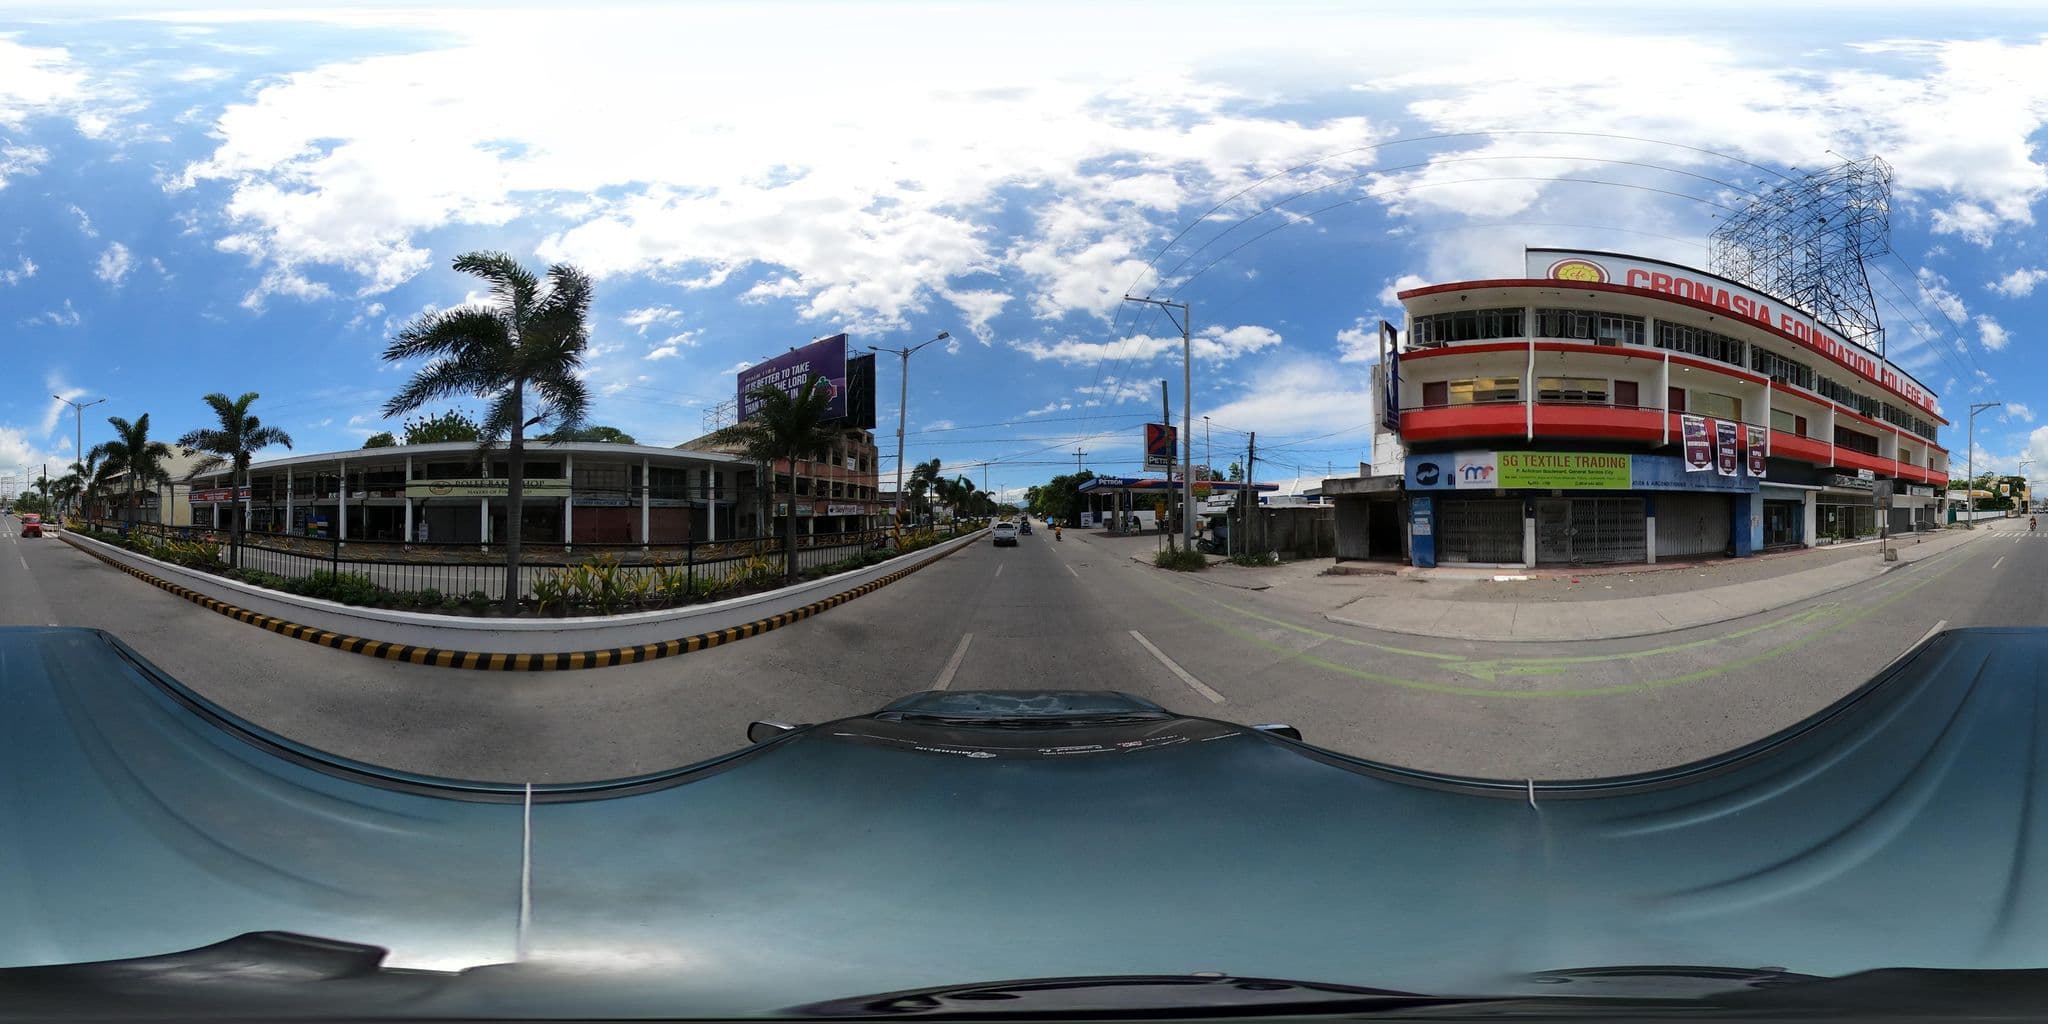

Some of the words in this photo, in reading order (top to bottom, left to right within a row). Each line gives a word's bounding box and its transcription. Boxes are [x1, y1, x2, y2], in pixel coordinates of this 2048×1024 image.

[1626, 268, 1771, 326] CRONASIA
[1780, 313, 1876, 380] FOUNDATION
[1881, 367, 1922, 405] COLLEGE
[757, 371, 780, 388] BETTER
[781, 368, 791, 379] TO
[792, 361, 810, 376] TAKE
[774, 379, 788, 391] THE
[788, 373, 808, 388] LORD
[790, 386, 799, 400] IN
[745, 399, 760, 415] THAN
[1502, 455, 1518, 467] 5G
[1523, 455, 1570, 468] TEXTILE
[1575, 456, 1626, 469] TRADING
